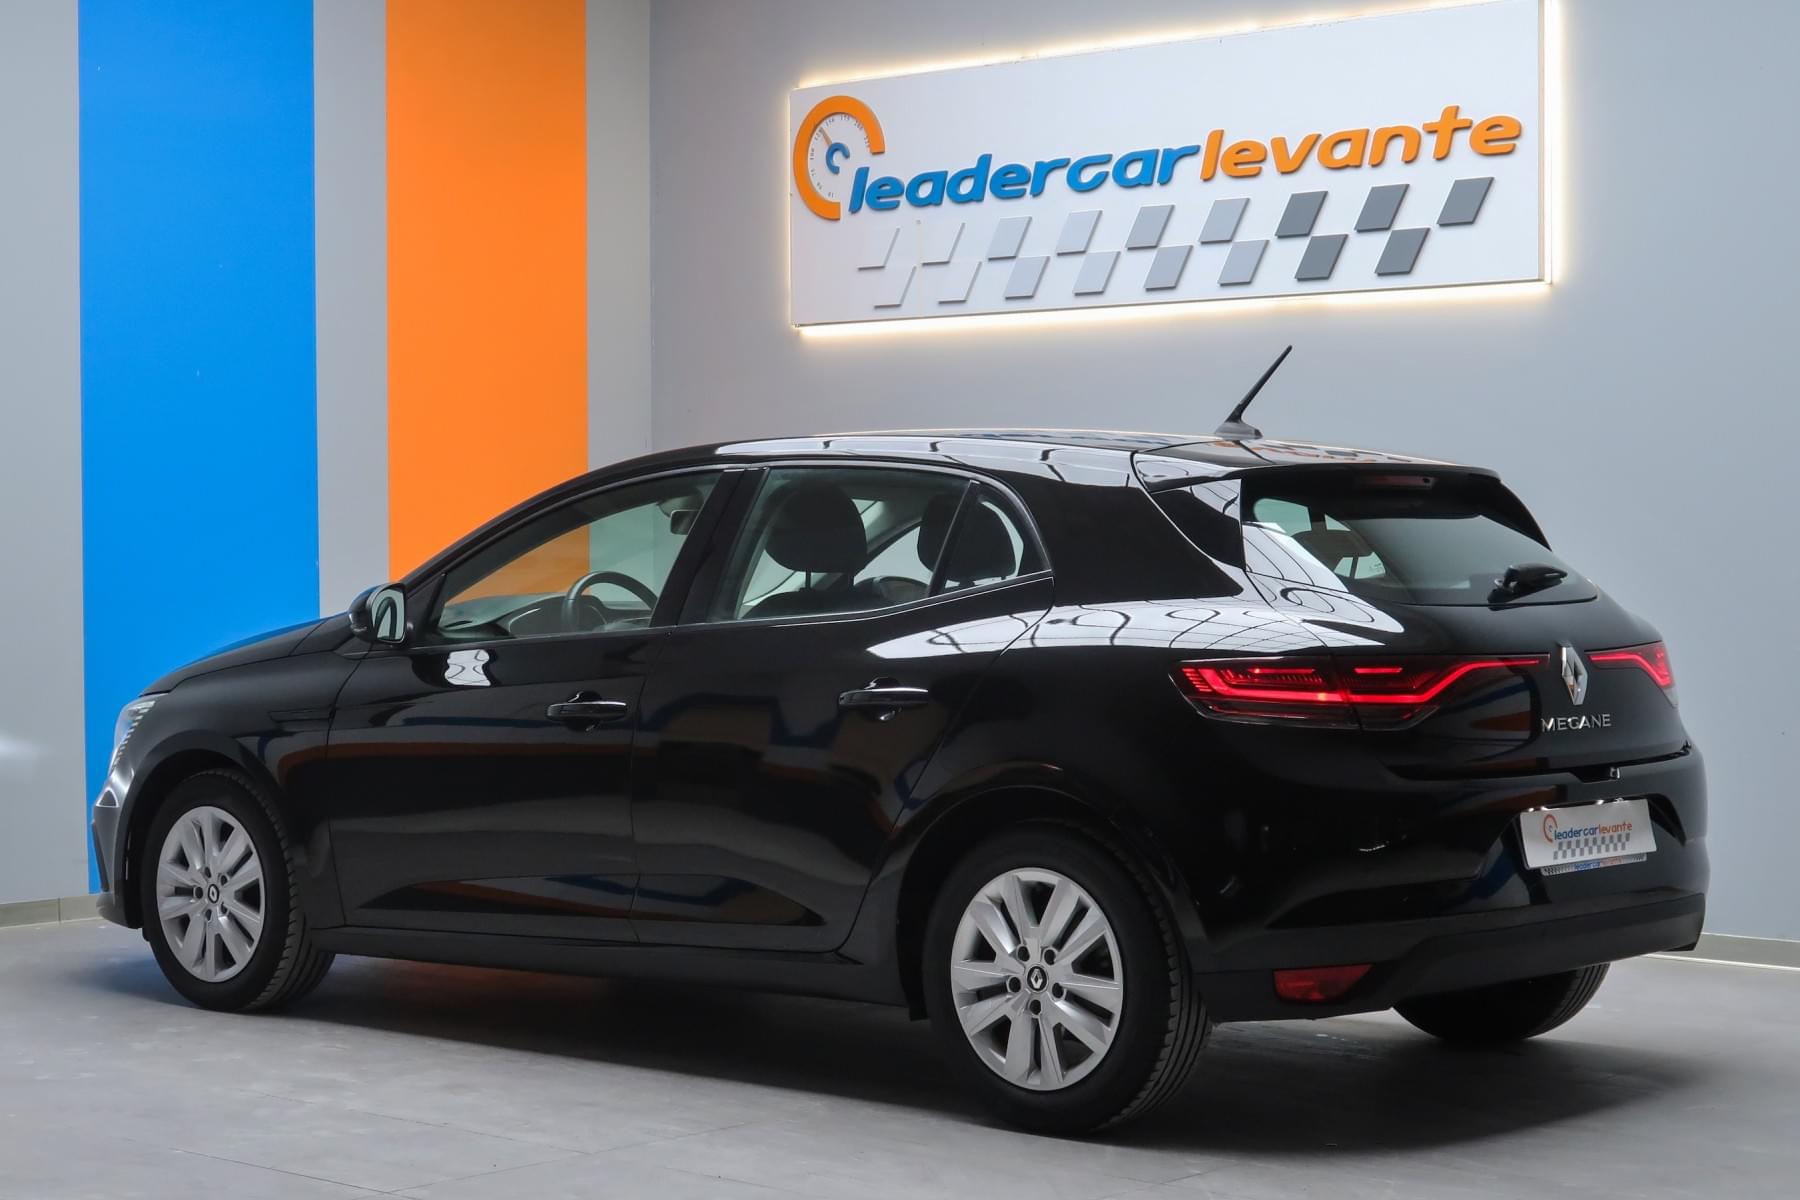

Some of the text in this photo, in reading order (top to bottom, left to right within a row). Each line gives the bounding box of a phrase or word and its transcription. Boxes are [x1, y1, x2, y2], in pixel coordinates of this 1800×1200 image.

[848, 105, 1522, 214] leadercarlevante
[1541, 714, 1611, 732] MEGANE
[1554, 821, 1632, 840] leadercarlevante
